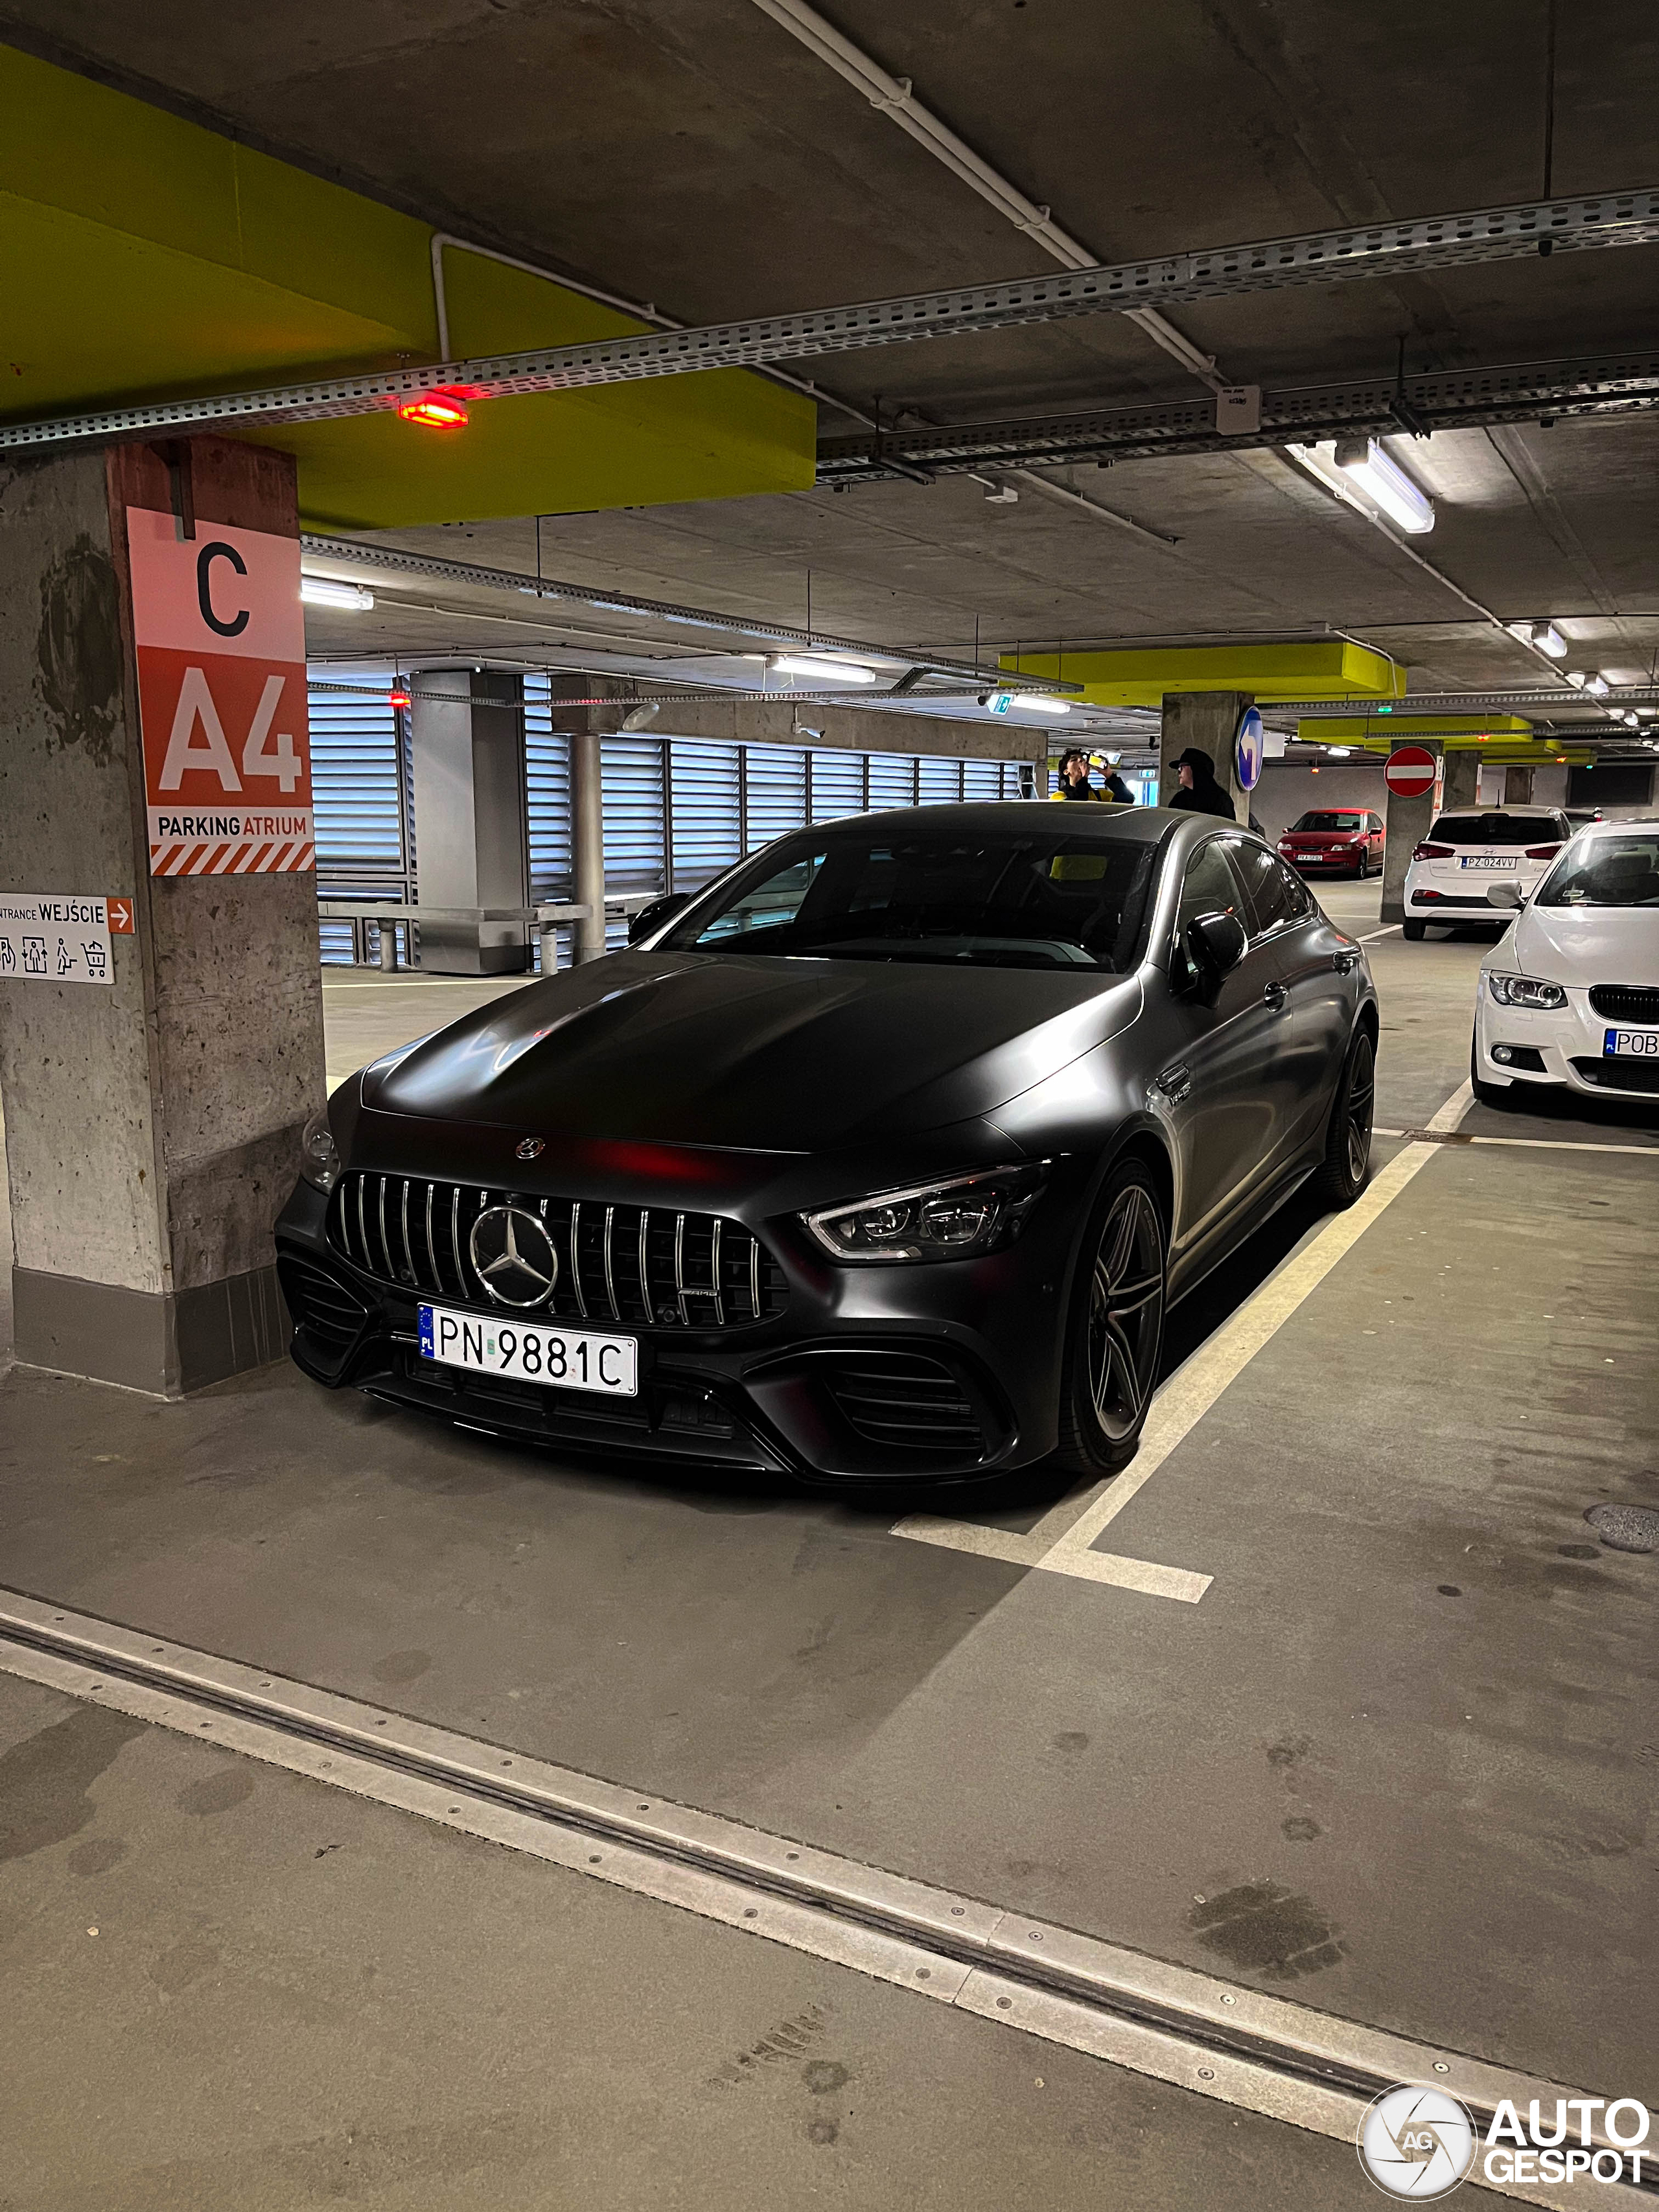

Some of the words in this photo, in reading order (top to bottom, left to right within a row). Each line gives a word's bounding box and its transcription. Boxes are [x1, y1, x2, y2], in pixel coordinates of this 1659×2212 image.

[197, 542, 249, 637] C
[159, 667, 302, 792] A4
[159, 817, 240, 835] PARKING
[243, 817, 307, 835] ATRIUM
[38, 900, 104, 924] WEJŚCIE
[1618, 1034, 1658, 1054] POB
[421, 1337, 433, 1350] PL
[440, 1316, 483, 1364] PN
[498, 1329, 621, 1386] 9881C
